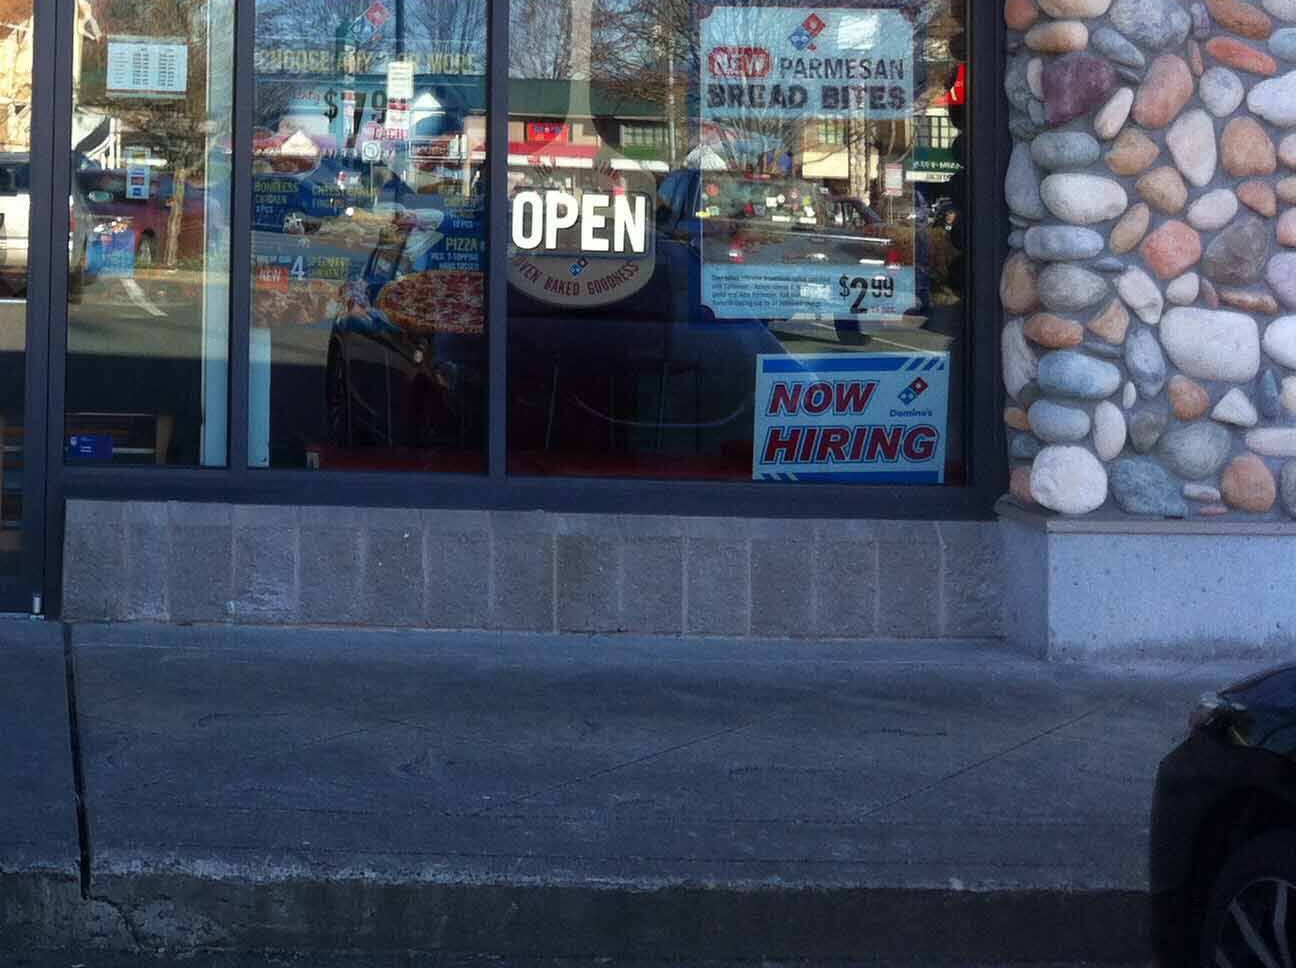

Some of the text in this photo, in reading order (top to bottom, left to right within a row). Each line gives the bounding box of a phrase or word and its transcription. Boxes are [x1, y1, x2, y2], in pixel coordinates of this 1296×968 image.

[780, 56, 905, 81] PARMESAN
[707, 83, 809, 109] BREAD
[512, 190, 646, 253] OPEN
[446, 237, 478, 252] PIZZA
[543, 276, 580, 296] BAKED
[587, 261, 639, 296] GOODNESS
[765, 379, 880, 416] NOW
[889, 408, 933, 418] Domino's
[760, 423, 940, 465] HIRING
